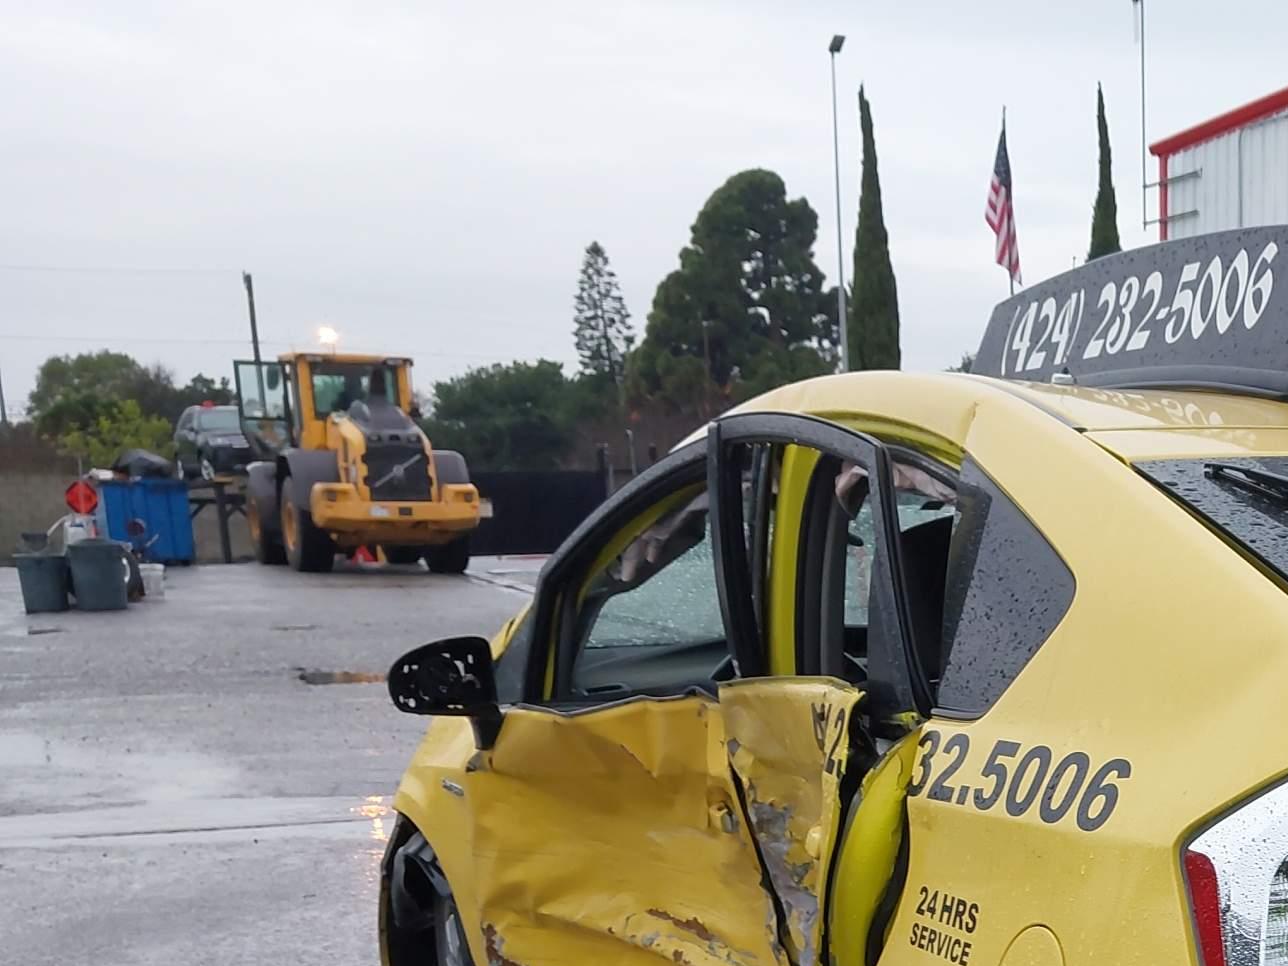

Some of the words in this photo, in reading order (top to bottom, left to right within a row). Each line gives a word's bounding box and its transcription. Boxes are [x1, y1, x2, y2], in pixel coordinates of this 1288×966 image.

[1001, 288, 1085, 376] (424)
[1083, 241, 1279, 360] 232-5006
[916, 885, 940, 920] 24
[938, 893, 979, 934] HRS
[909, 922, 972, 966] SERVICE
